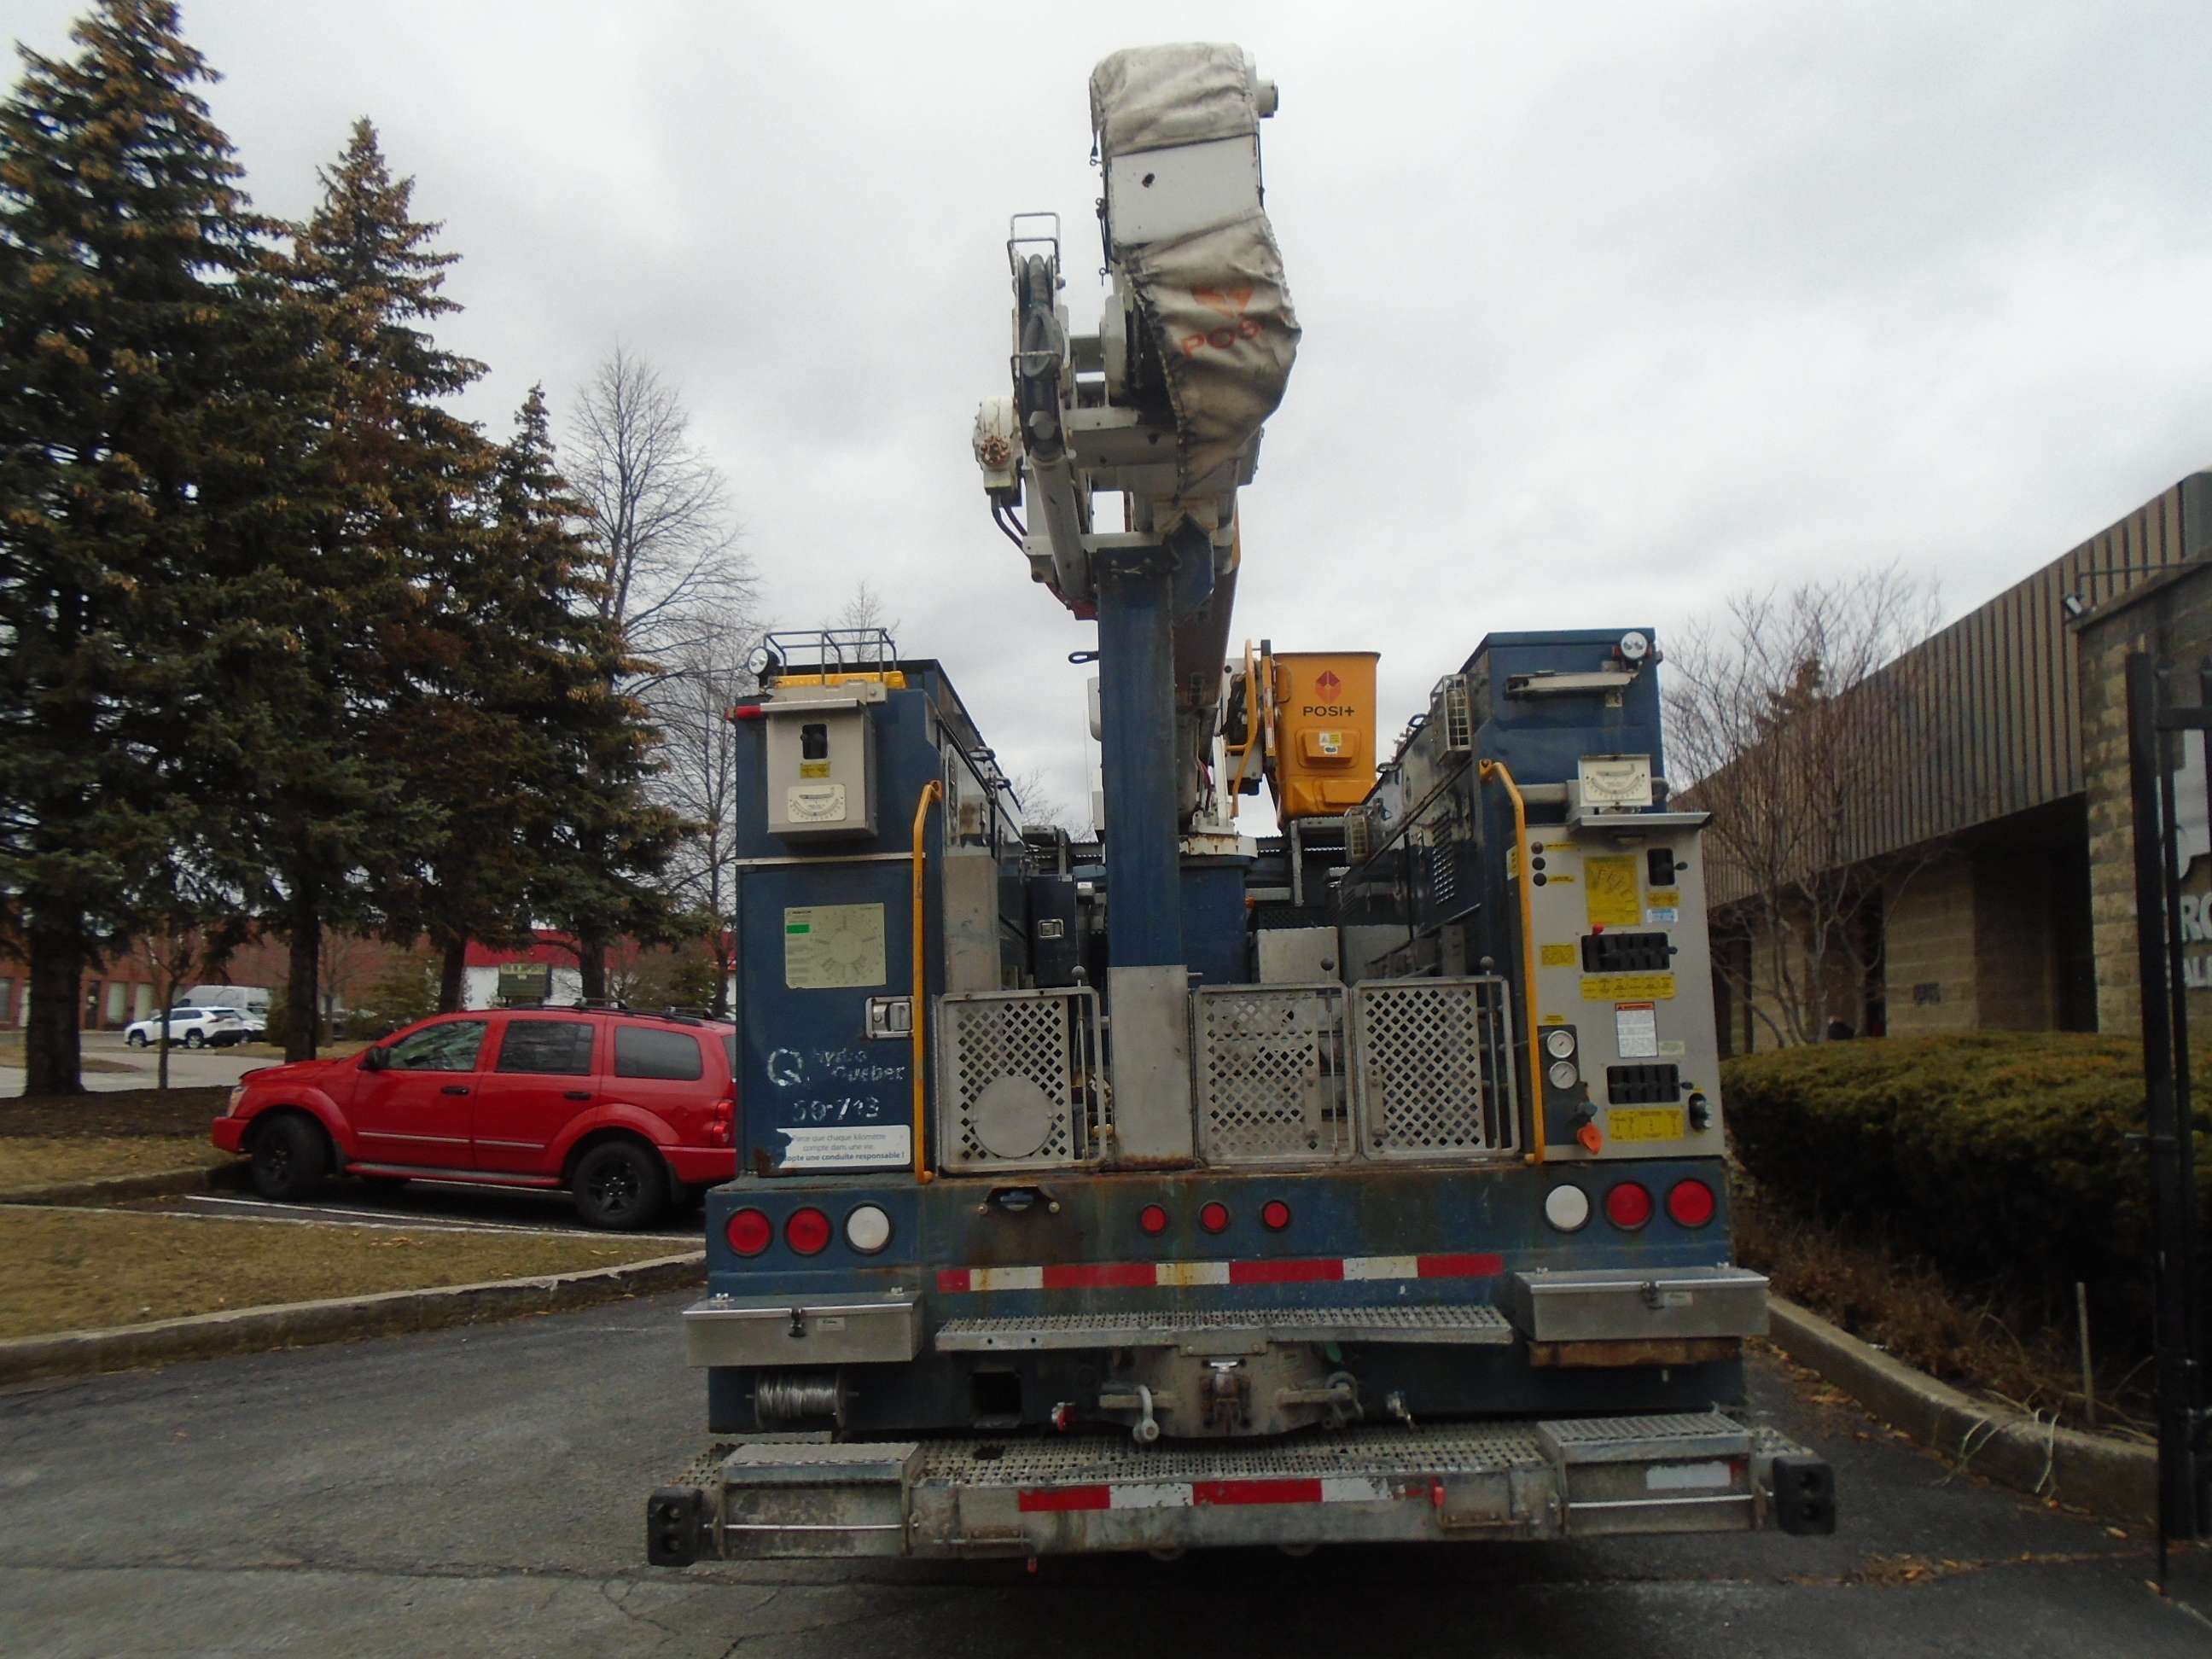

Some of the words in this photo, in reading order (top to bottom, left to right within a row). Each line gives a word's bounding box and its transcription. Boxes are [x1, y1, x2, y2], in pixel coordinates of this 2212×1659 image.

[1303, 706, 1355, 717] POSI+
[826, 1134, 852, 1143] chaque
[803, 1144, 829, 1153] compte
[785, 1155, 804, 1163] opte
[856, 1152, 900, 1161] responsable
